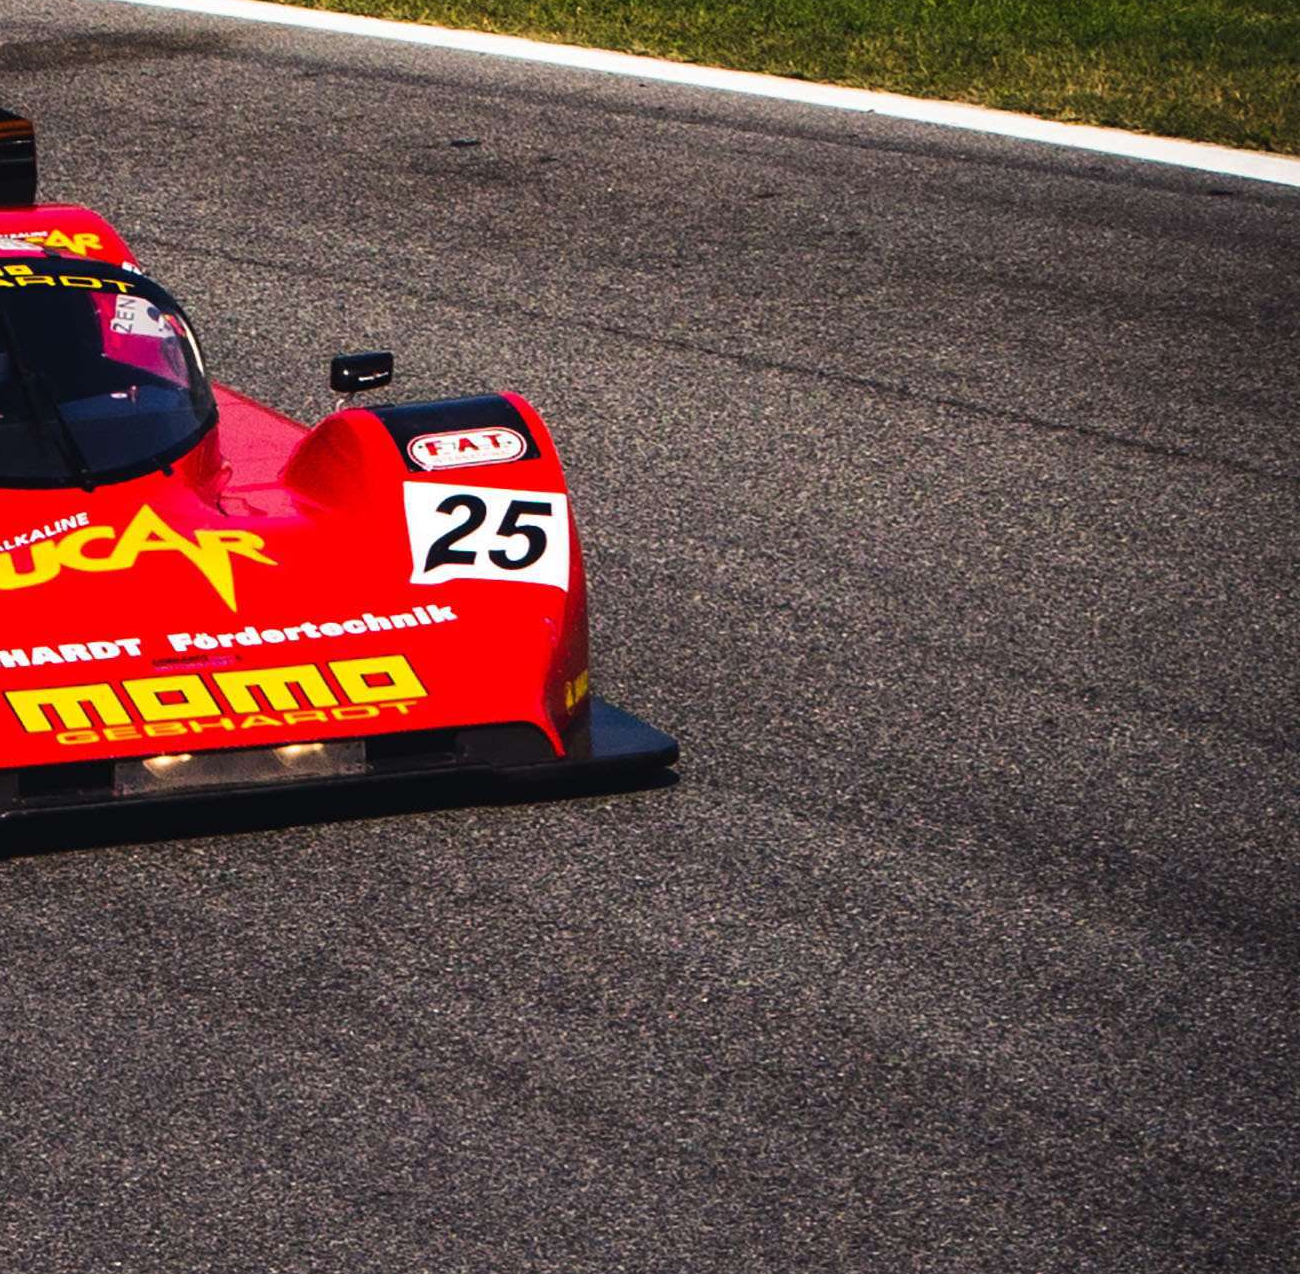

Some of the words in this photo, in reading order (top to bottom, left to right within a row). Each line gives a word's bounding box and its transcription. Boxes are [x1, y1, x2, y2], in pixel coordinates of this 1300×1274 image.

[25, 229, 103, 257] AR
[113, 297, 137, 333] ZEN
[424, 494, 553, 573] 25
[56, 700, 418, 745] GEBHARDT
